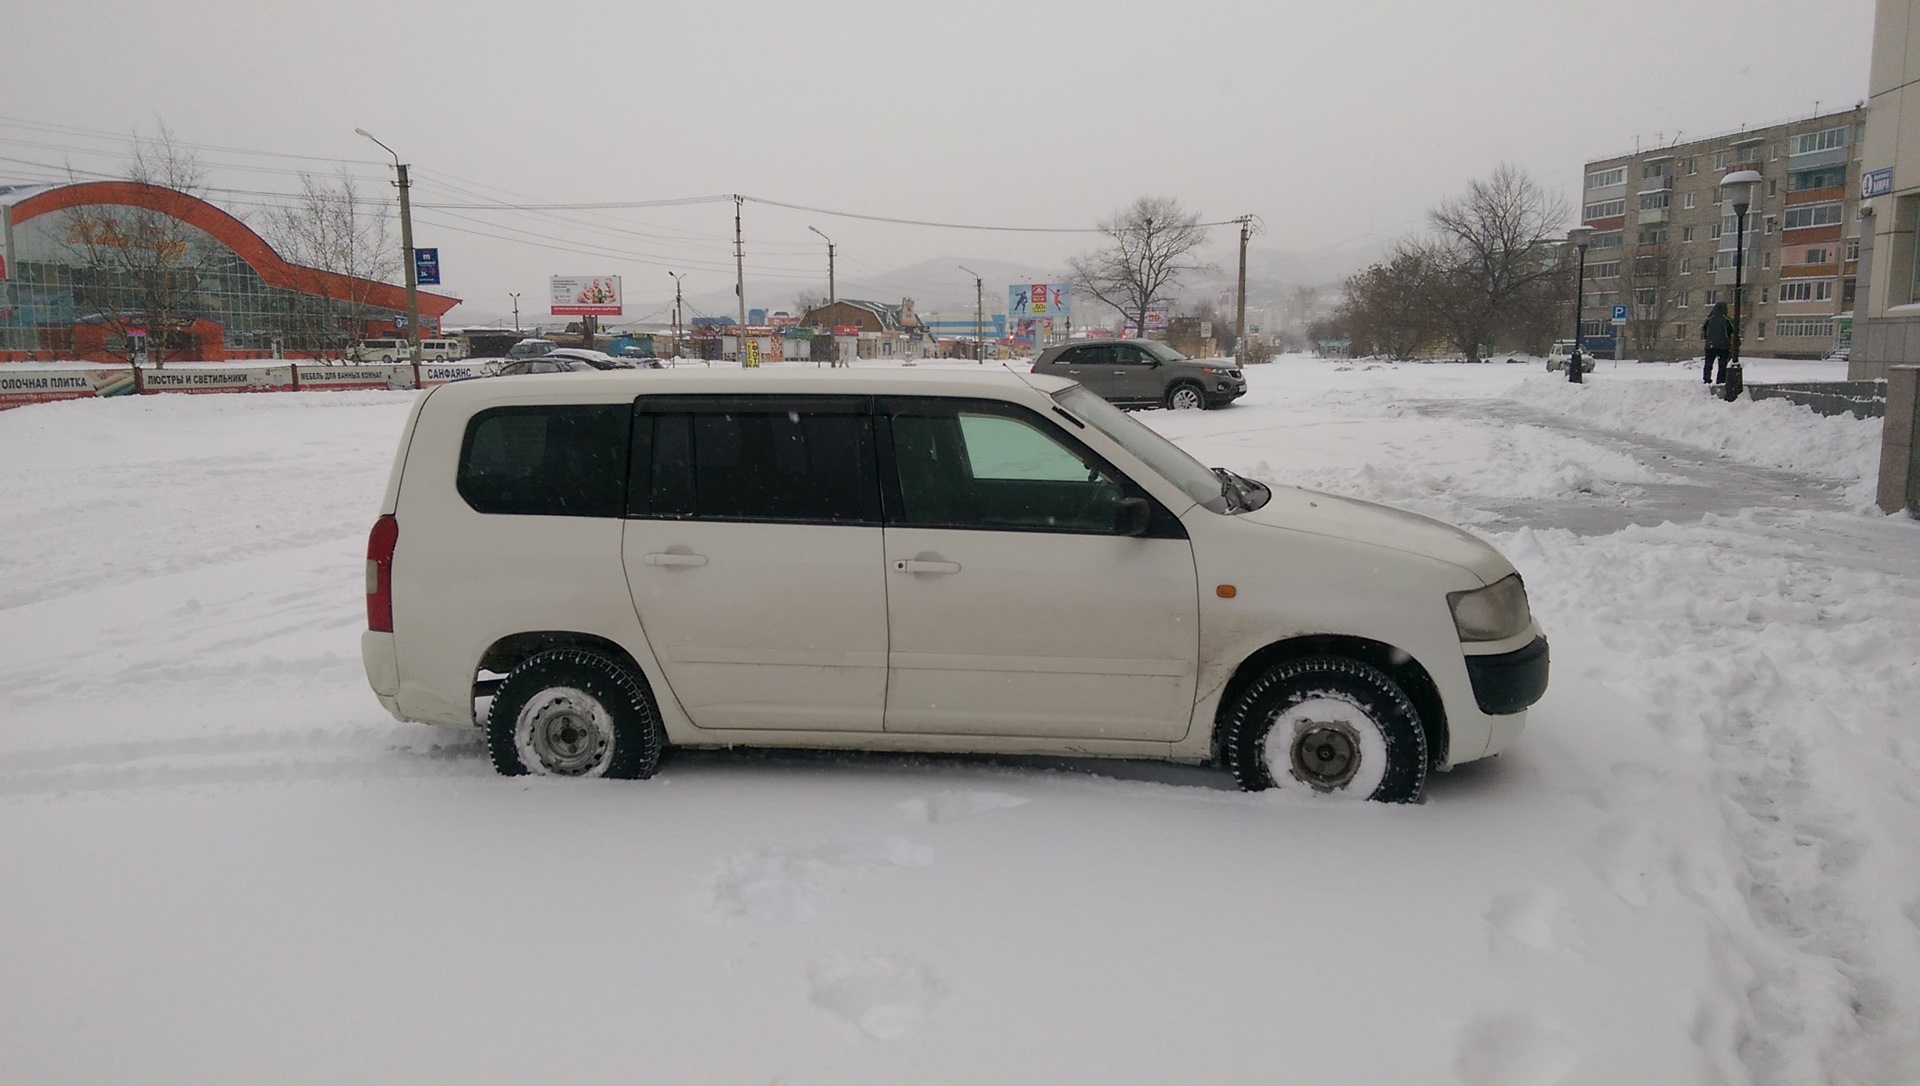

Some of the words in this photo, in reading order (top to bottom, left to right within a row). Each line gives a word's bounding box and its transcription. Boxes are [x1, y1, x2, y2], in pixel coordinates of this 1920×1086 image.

[147, 375, 184, 385] ЛЮСТРЫ
[185, 375, 192, 384] И
[193, 373, 248, 384] СВЕТИЛЬНИКИ
[300, 372, 324, 380] МЕБЕЛЬ
[325, 372, 337, 380] ДЛЯ
[337, 371, 360, 379] ВАННЫХ
[361, 371, 383, 379] КОМНАТ
[427, 368, 472, 380] САНФАЯНС
[0, 378, 48, 390] ОЛОЧНАЯ
[50, 377, 87, 388] ПЛИТКА
